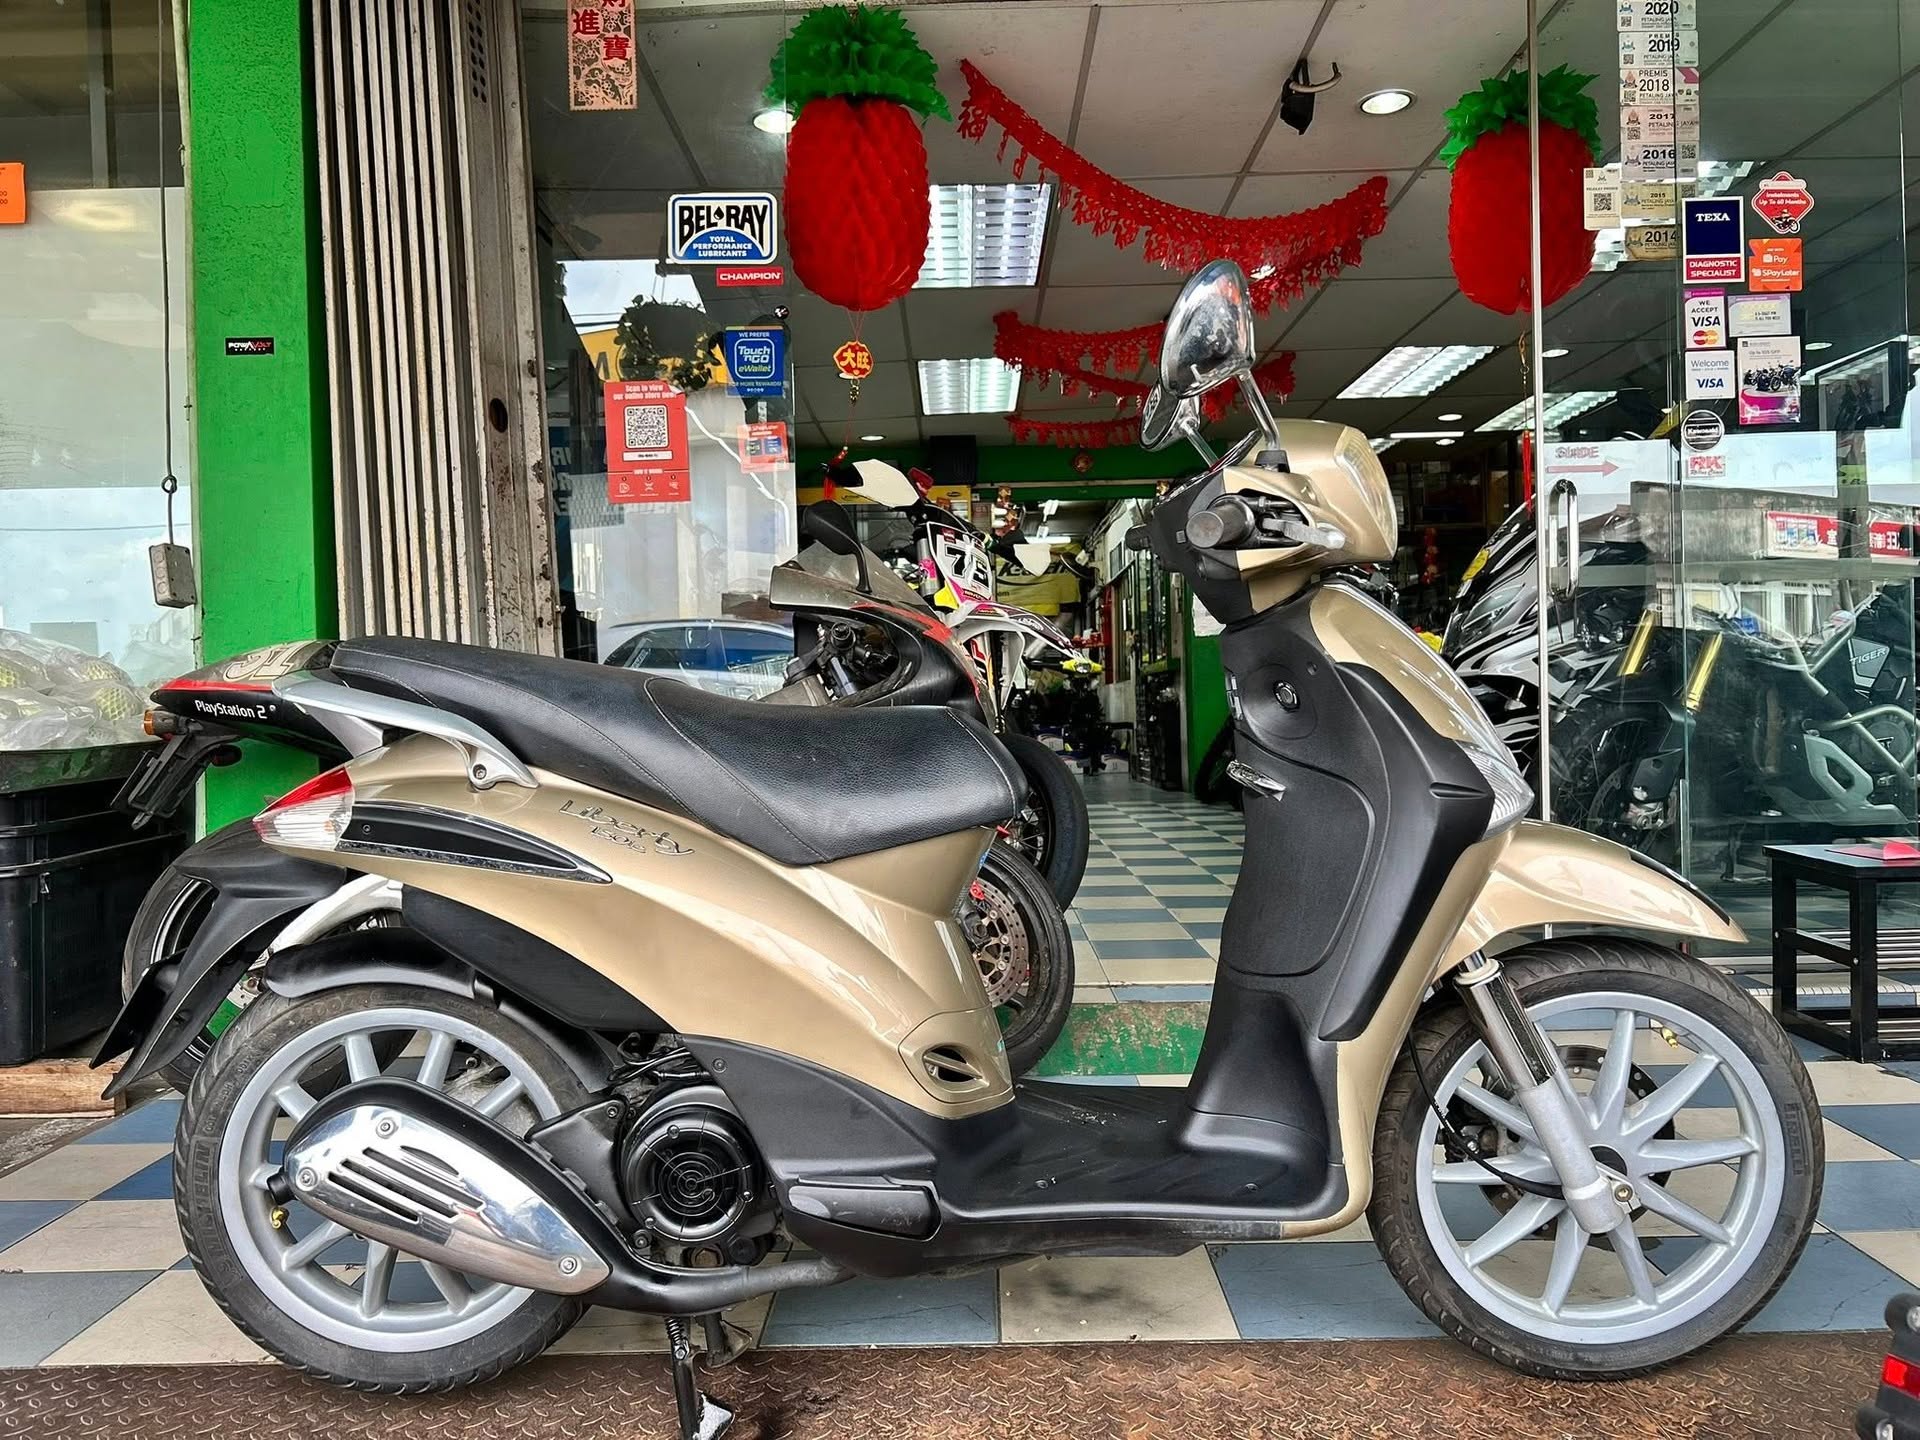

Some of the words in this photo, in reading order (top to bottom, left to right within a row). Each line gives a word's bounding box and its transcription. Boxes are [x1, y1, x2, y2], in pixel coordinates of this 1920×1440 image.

[1645, 1, 1679, 15] 2020
[573, 9, 600, 34] 進
[603, 35, 631, 60] 寶
[1648, 38, 1680, 52] 2019
[1638, 69, 1668, 77] PREMIS
[1639, 79, 1670, 92] 2018
[1643, 149, 1676, 159] 2016
[1695, 213, 1731, 222] TEXA
[1645, 230, 1677, 243] 2014
[1689, 260, 1738, 268] DIAGNOSTIC
[1773, 255, 1789, 265] Pay
[719, 272, 781, 281] CHAMPION
[1690, 269, 1737, 278] SPECIALIST
[1762, 269, 1800, 278] SPayLater
[1691, 316, 1721, 327] VISA
[738, 346, 771, 356] Touch
[738, 364, 772, 373] eWallet
[1691, 359, 1730, 368] Welcome
[625, 384, 641, 393] Scan
[648, 383, 664, 392] view
[1696, 378, 1725, 388] VISA
[624, 392, 644, 400] online
[1850, 646, 1887, 664] TIGER
[194, 699, 256, 718] PlayStation
[256, 704, 268, 719] 2
